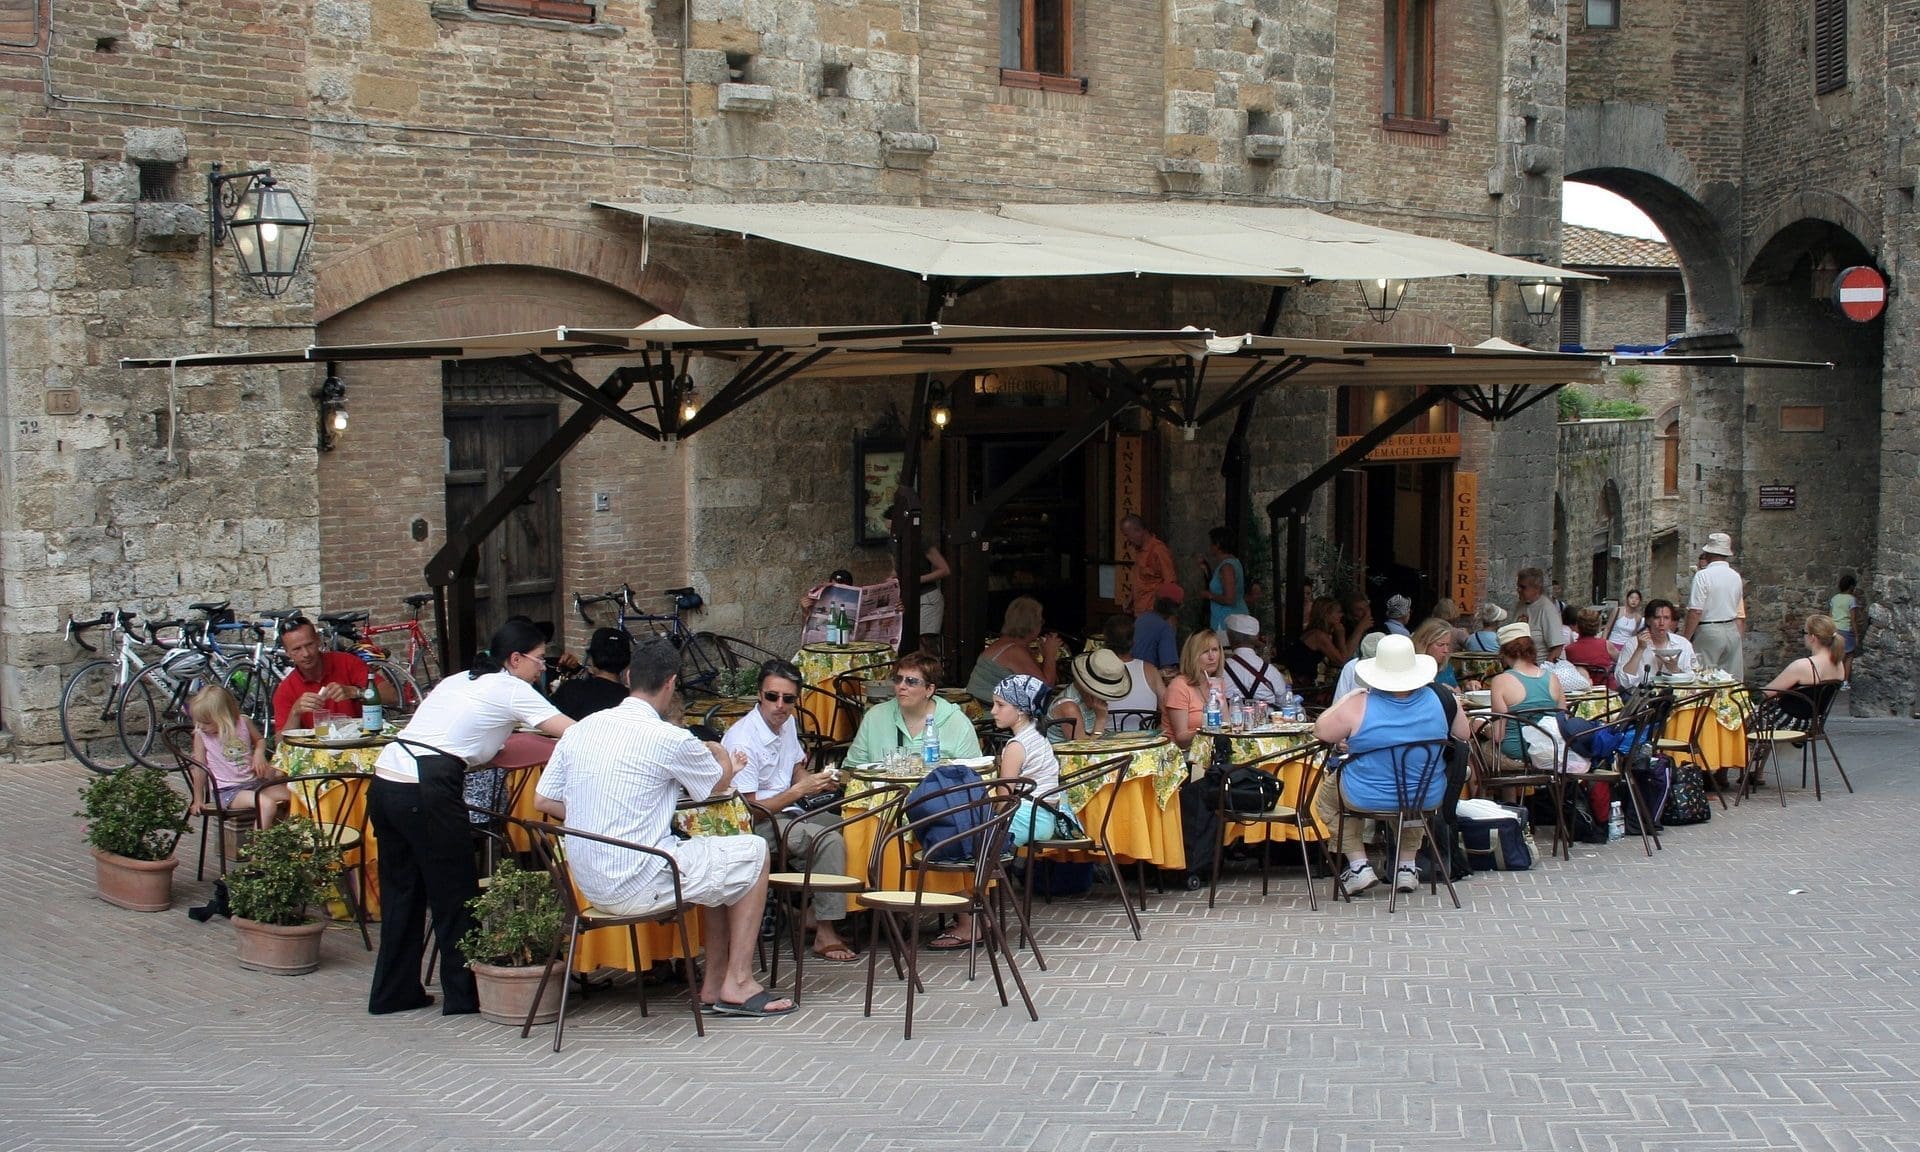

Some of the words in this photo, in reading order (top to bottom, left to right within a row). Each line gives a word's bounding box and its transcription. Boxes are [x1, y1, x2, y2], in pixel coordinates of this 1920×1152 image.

[20, 420, 39, 434] 32
[1398, 435, 1414, 446] ICE
[1419, 434, 1451, 445] CREAM
[1431, 445, 1446, 455] EIS
[1122, 440, 1133, 518] INSALAT
[1458, 492, 1471, 612] GELATERIA
